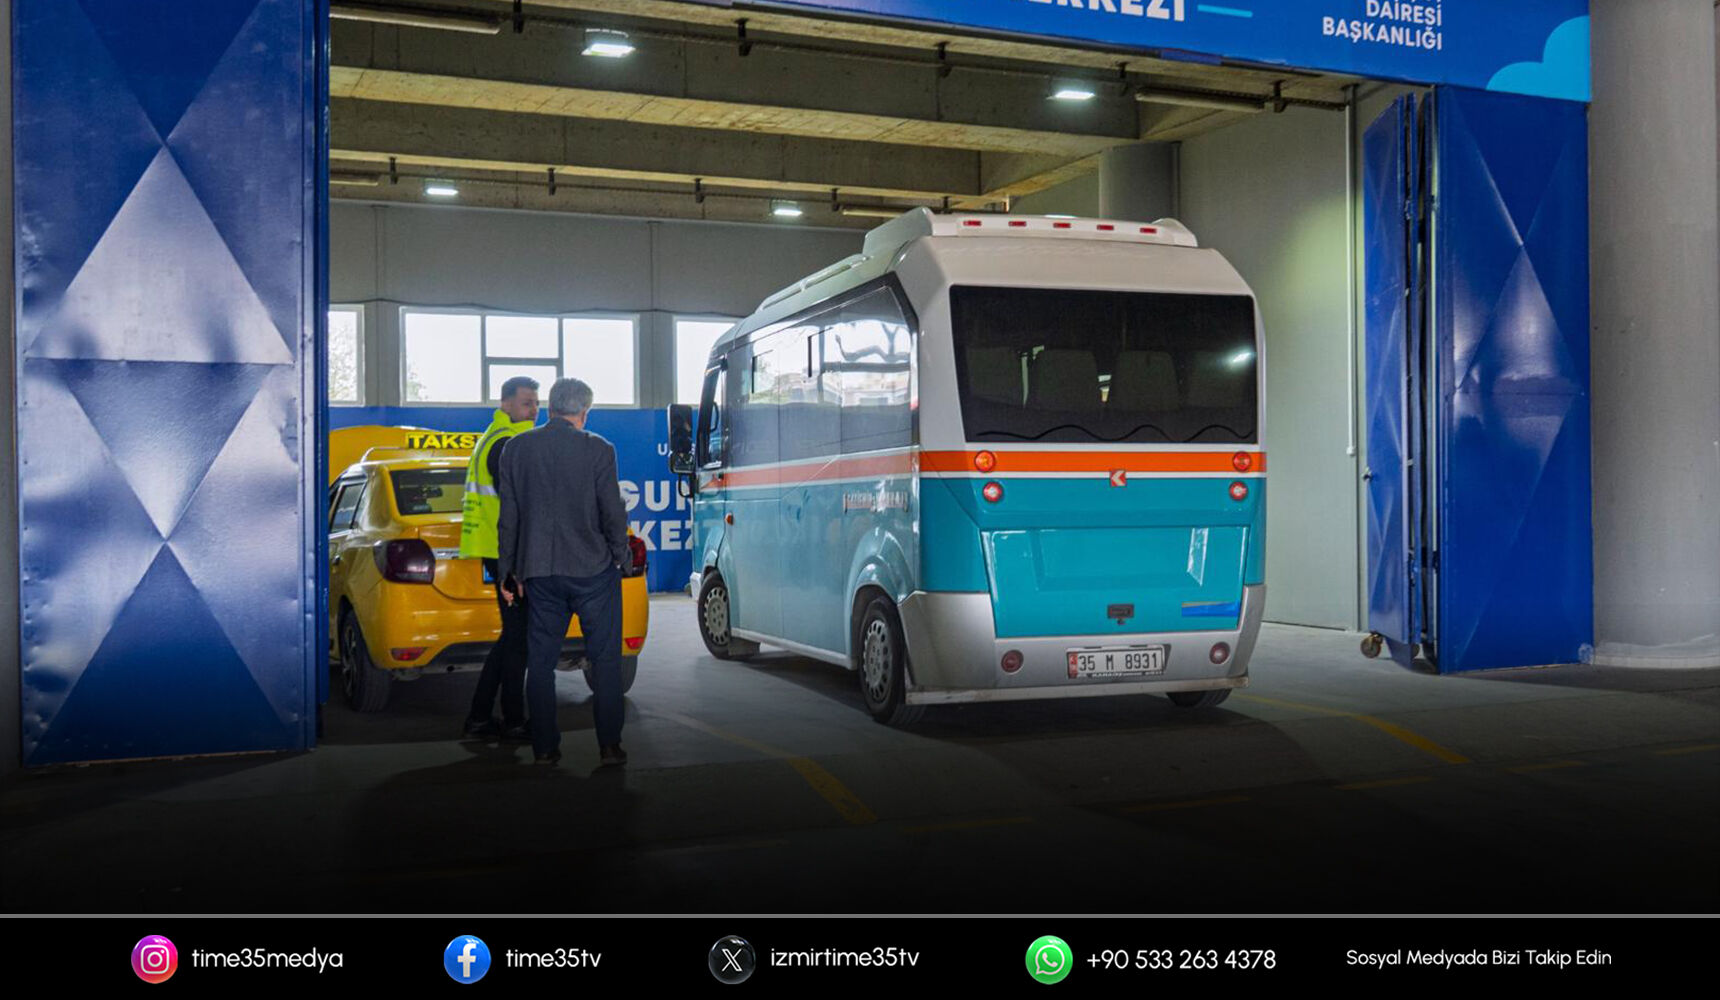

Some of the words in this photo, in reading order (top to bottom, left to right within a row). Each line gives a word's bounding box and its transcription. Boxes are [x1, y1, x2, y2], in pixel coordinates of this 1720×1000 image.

[1365, 0, 1442, 27] DAİRESİ
[1322, 16, 1442, 51] BAŞKANLIĞI
[1079, 655, 1096, 672] 35
[1106, 654, 1115, 671] M
[1125, 652, 1158, 670] 8931
